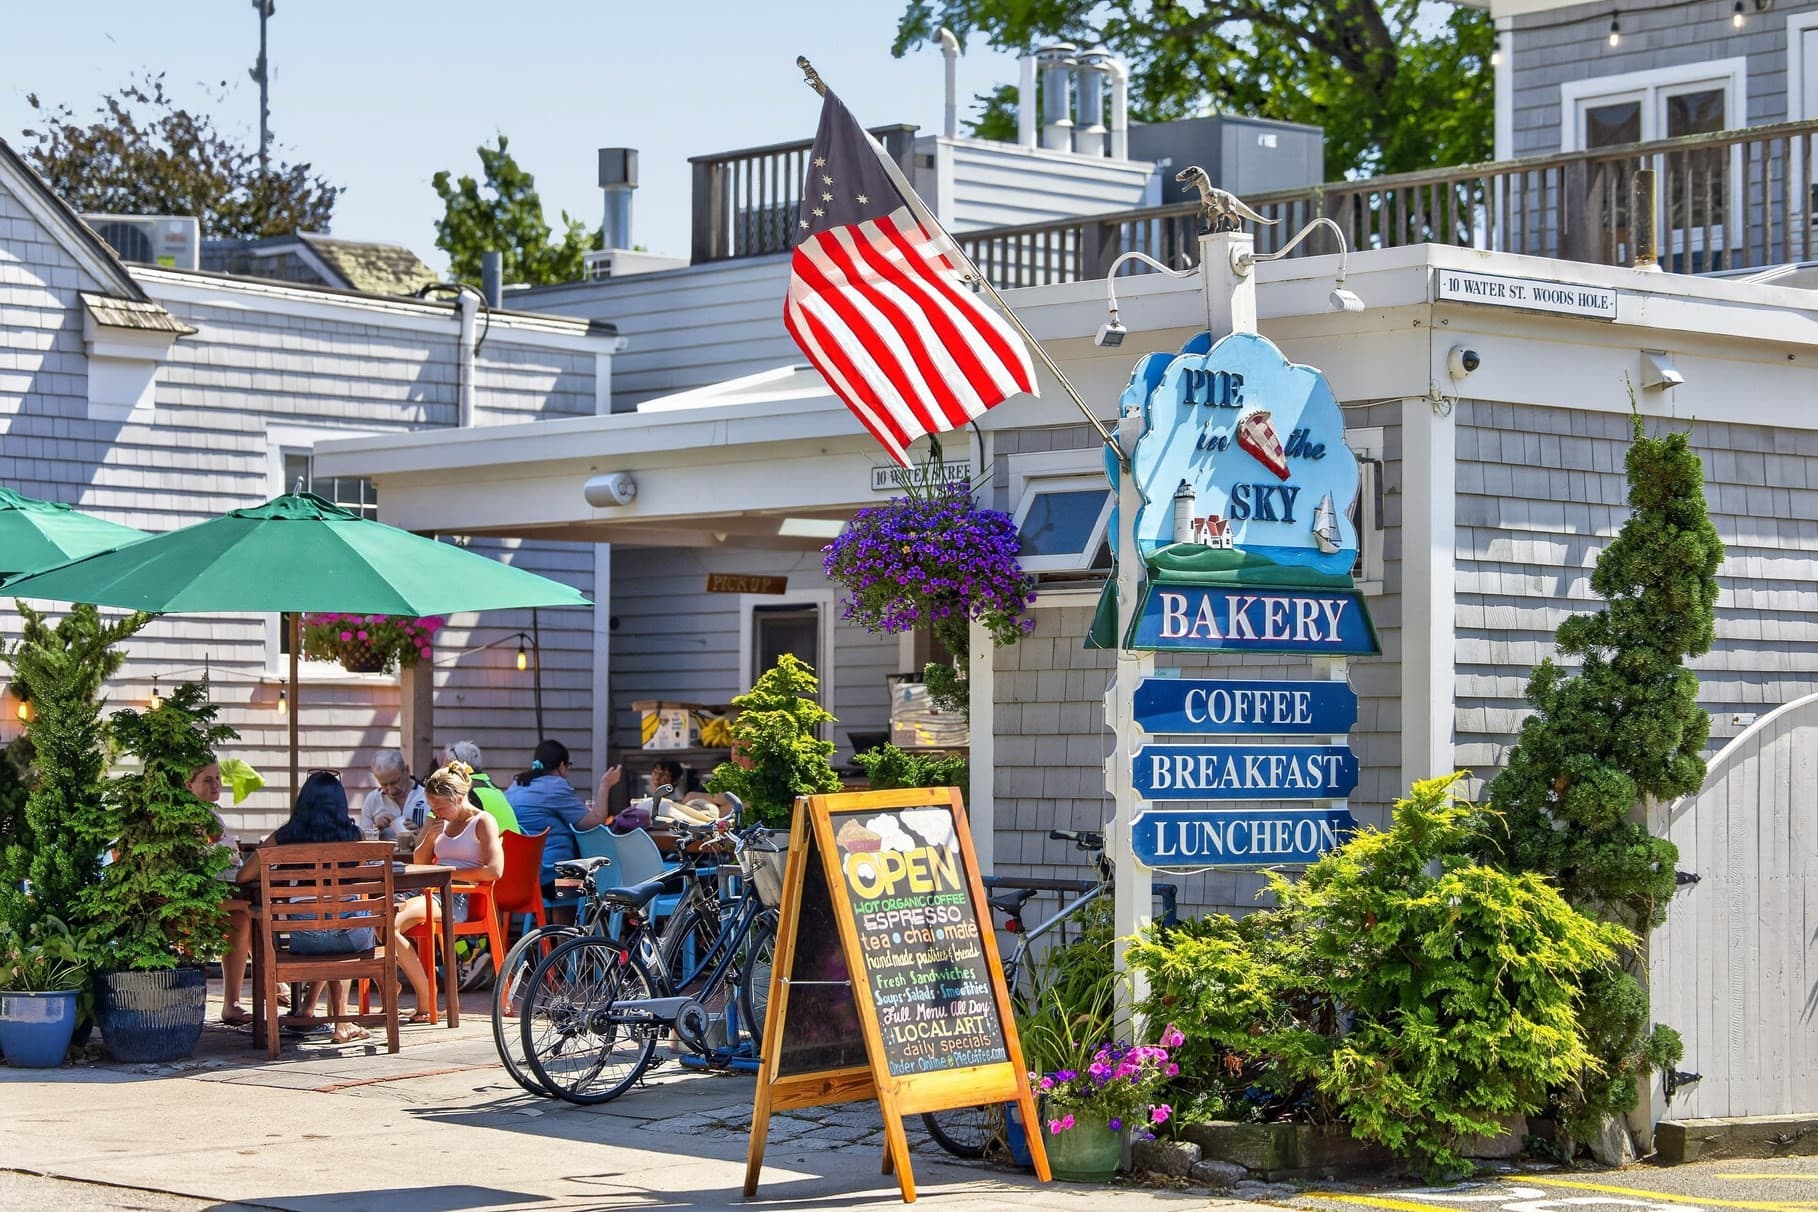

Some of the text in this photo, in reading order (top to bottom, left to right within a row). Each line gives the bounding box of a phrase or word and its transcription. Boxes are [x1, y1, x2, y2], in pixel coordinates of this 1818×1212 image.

[1449, 278, 1609, 310] 10 WATER ST. WOODS HOLE
[1183, 367, 1244, 409] PIE
[1196, 420, 1327, 461] in the
[876, 470, 886, 485] 10
[1231, 482, 1301, 523] SKY
[1159, 592, 1348, 642] BAKERY
[1184, 688, 1312, 724] COFFEE
[1150, 754, 1342, 790] BREAKFAST
[1154, 819, 1340, 856] LUNCHEON
[847, 846, 961, 899] OPEN
[854, 893, 966, 914] HOT ORGANIC COFFEE
[863, 906, 962, 931] ESPRESSO
[861, 931, 891, 951] tea
[904, 924, 936, 944] chai
[865, 948, 914, 970] handmade
[916, 947, 948, 969] pastries
[951, 941, 980, 961] breads
[876, 966, 976, 989] Fresh Sandwiches
[874, 981, 989, 1007] Soups Salads Smoothies
[883, 999, 990, 1025] Full Menu All Day
[893, 1015, 985, 1043] LOCAL ART
[903, 1034, 991, 1059] daily specials
[889, 1060, 915, 1076] Order
[918, 1055, 947, 1072] Online
[953, 1047, 1006, 1067] PieCoffee.com
